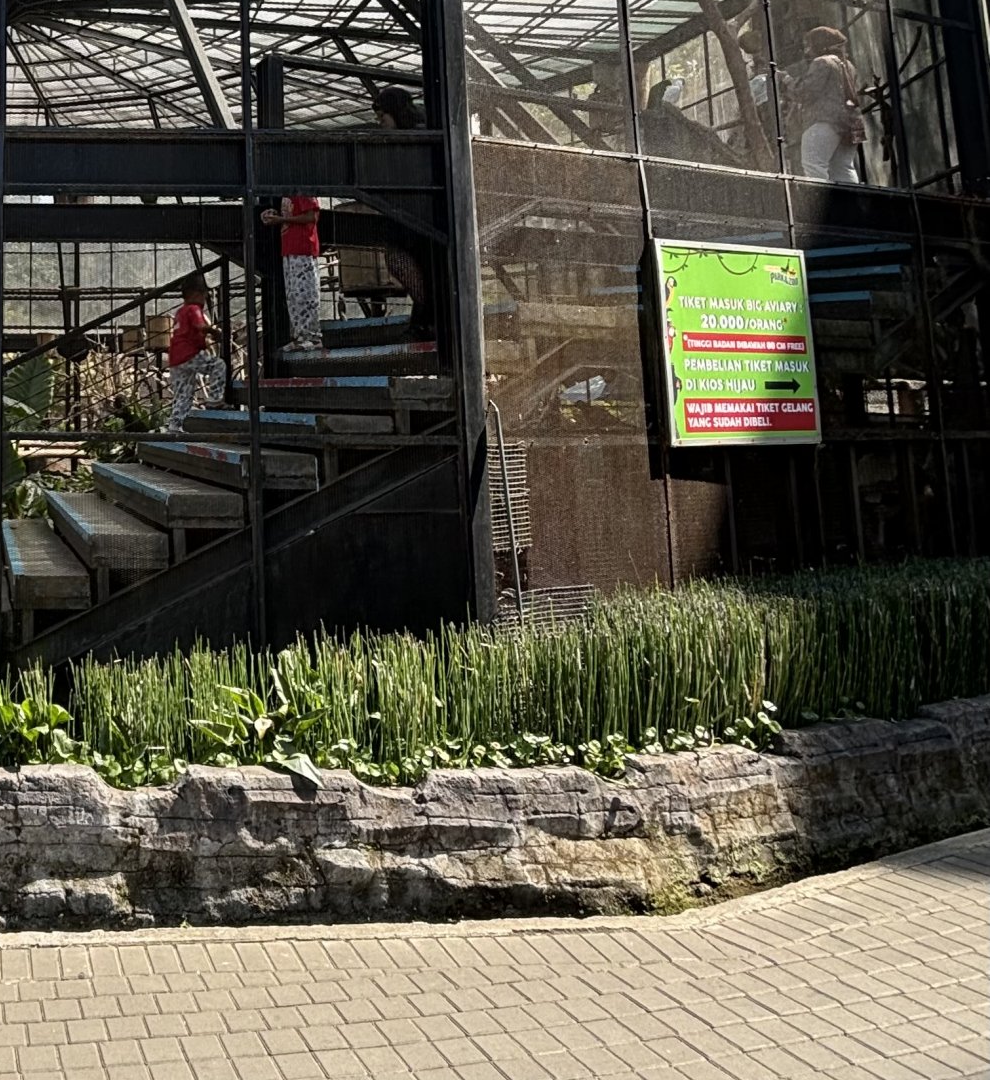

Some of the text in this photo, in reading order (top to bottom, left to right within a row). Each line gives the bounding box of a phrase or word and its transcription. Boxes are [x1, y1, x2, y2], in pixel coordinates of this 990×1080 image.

[678, 296, 706, 309] TIKET
[710, 297, 744, 311] MASUK
[747, 299, 762, 311] BIG
[765, 300, 797, 313] AVIARY
[684, 359, 809, 373] PEMBELIAN TIKET MASUK
[686, 379, 755, 393] DI KIOS HIJAU
[686, 403, 813, 415] WAJIB MEMAKAI TIKET GELANG
[688, 416, 772, 428] YANG SUDAH DIBELI.
